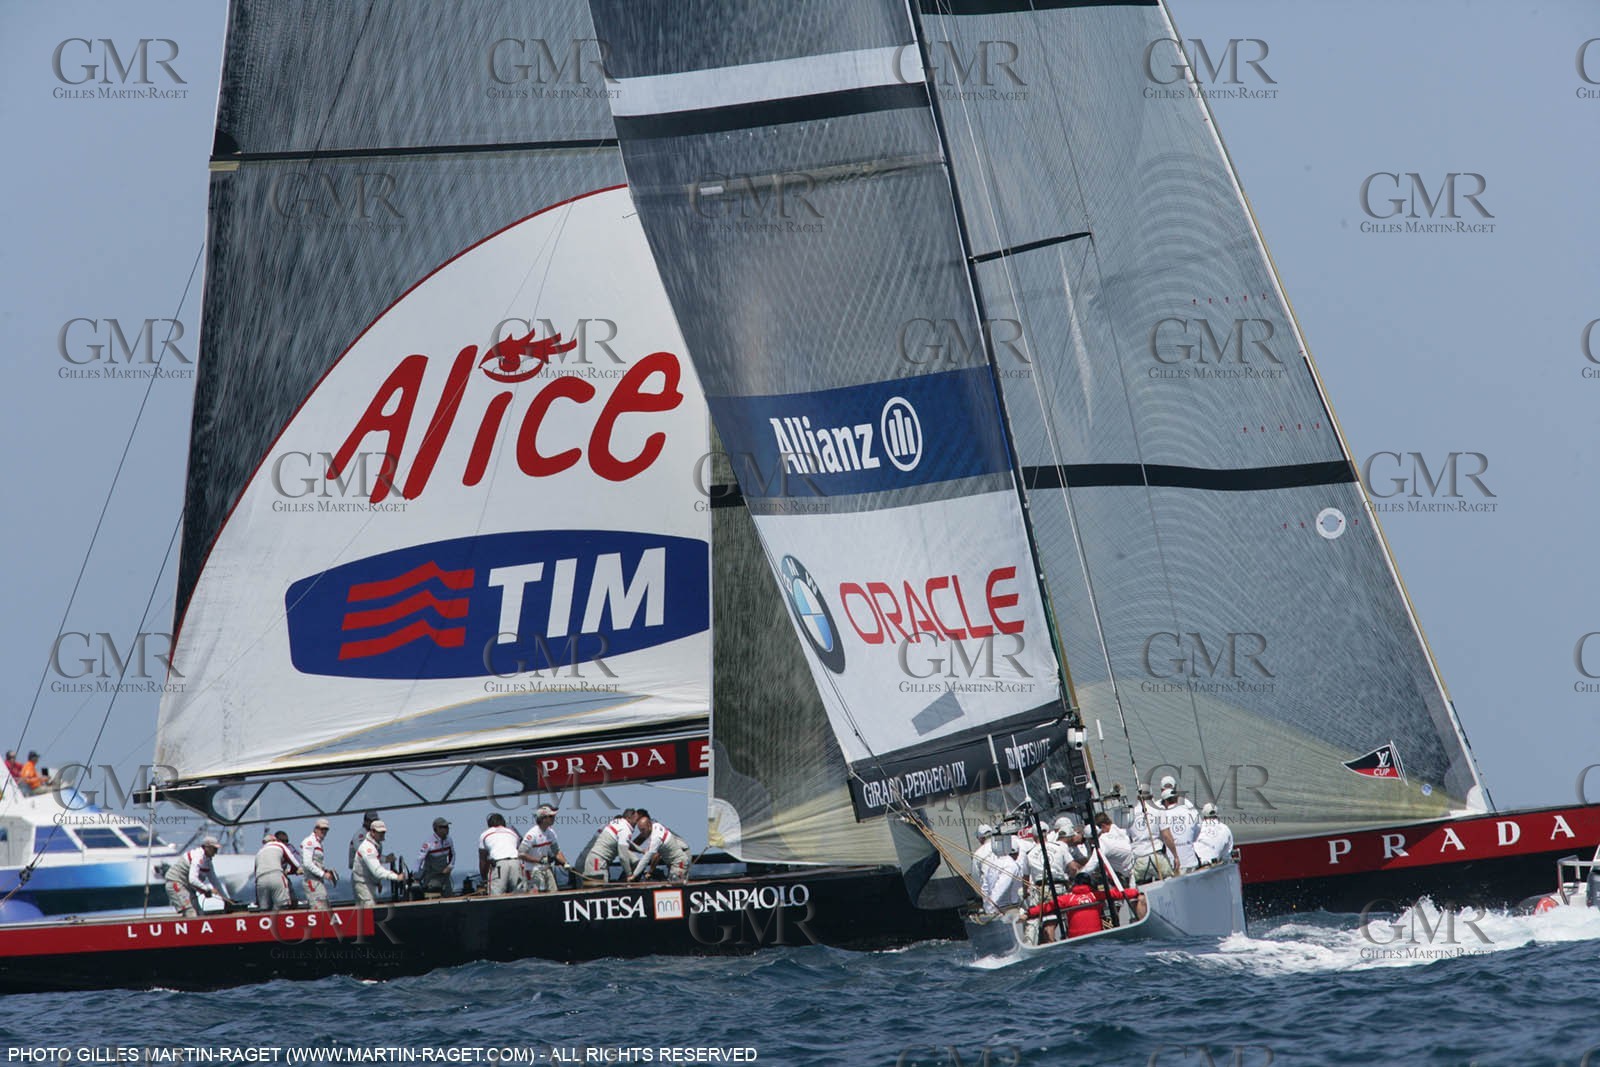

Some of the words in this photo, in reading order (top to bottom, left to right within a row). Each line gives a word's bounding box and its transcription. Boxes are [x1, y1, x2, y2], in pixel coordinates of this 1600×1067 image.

[326, 345, 684, 504] Alice
[769, 415, 880, 474] Allianz
[488, 547, 666, 644] TIM
[839, 566, 1025, 644] ORACLE
[542, 749, 666, 777] PRADA
[1373, 768, 1391, 777] CUP
[1328, 815, 1575, 865] PRADA
[128, 920, 213, 938] LUNA
[236, 913, 343, 931] ROSSA
[563, 896, 647, 922] INTESA
[690, 884, 810, 915] SANPAOLO
